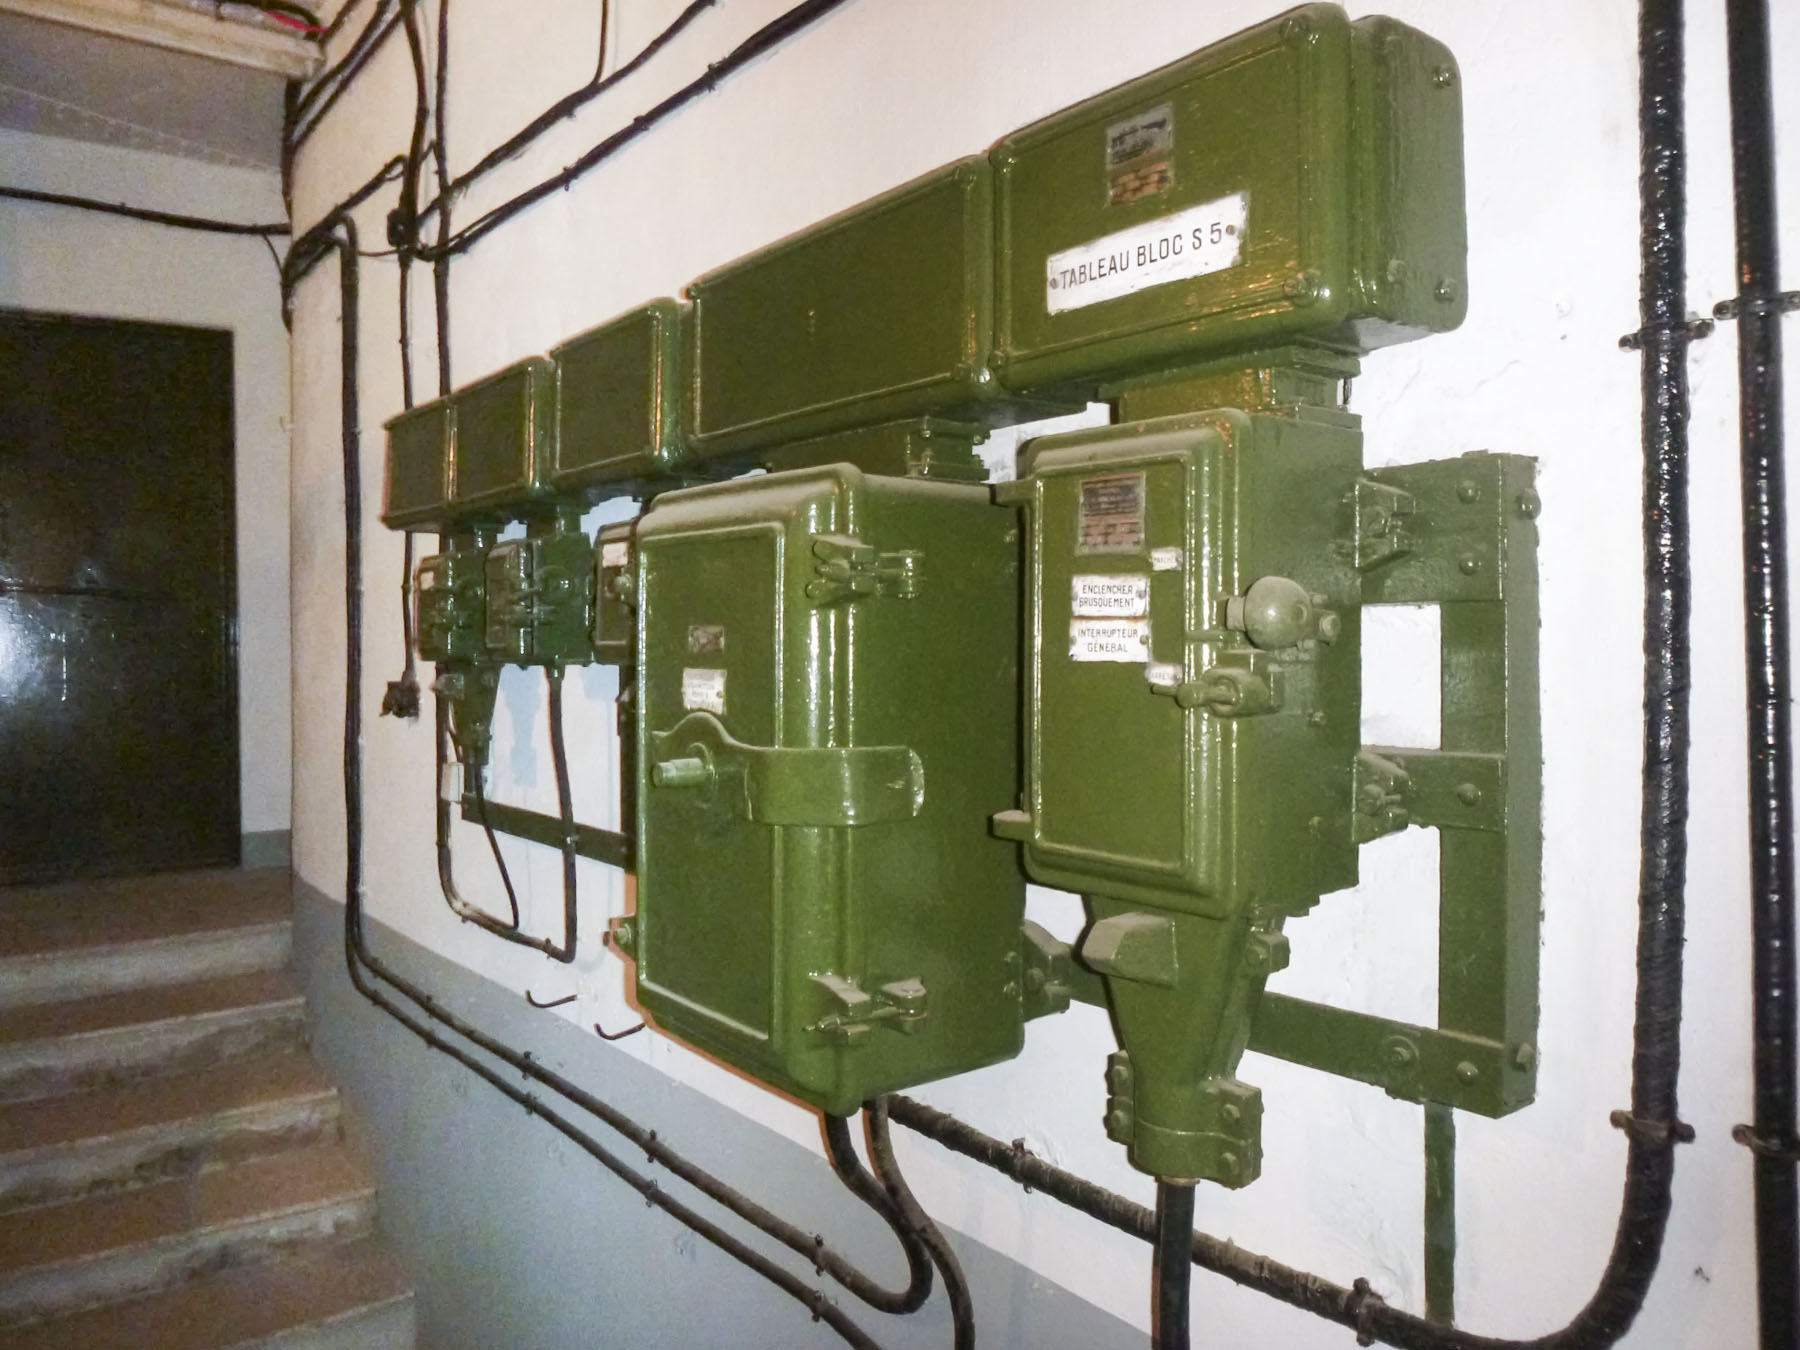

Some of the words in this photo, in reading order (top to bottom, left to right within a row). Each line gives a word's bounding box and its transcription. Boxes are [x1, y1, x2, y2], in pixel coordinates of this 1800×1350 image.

[1060, 251, 1129, 290] TABLEAU
[1137, 234, 1183, 267] BLOC
[1192, 228, 1202, 250] S
[1210, 222, 1222, 245] 5
[1082, 584, 1134, 595] ENCLENCHER
[1079, 597, 1135, 608] BRUSQUEMENT
[1078, 628, 1138, 638] INTERRUPTEUR
